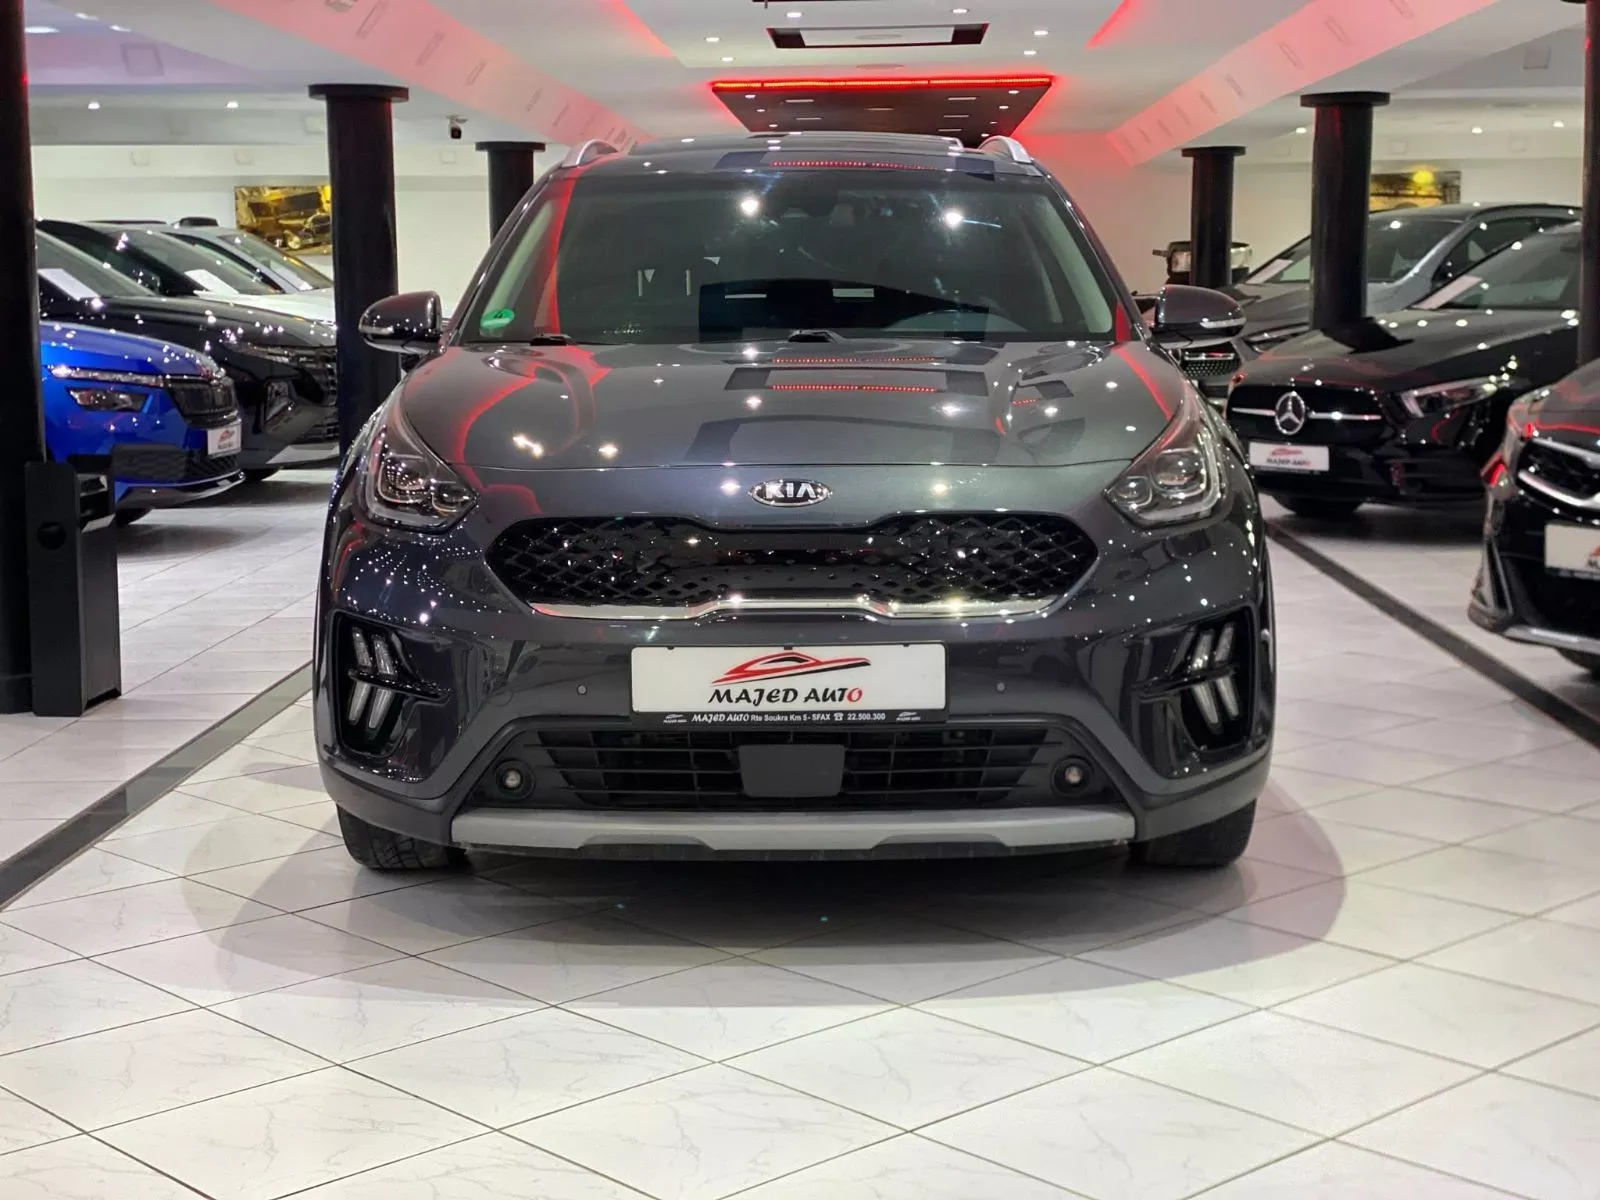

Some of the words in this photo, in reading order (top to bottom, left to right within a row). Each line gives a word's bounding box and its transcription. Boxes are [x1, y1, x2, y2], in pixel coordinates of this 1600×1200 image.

[765, 482, 816, 499] KIA
[708, 688, 798, 706] MAJED
[804, 687, 863, 703] AUTO
[692, 713, 725, 723] MAJED
[727, 713, 749, 722] AUTO
[790, 713, 802, 721] Km
[812, 713, 830, 721] SFAX
[847, 712, 886, 721] 22.500.300
